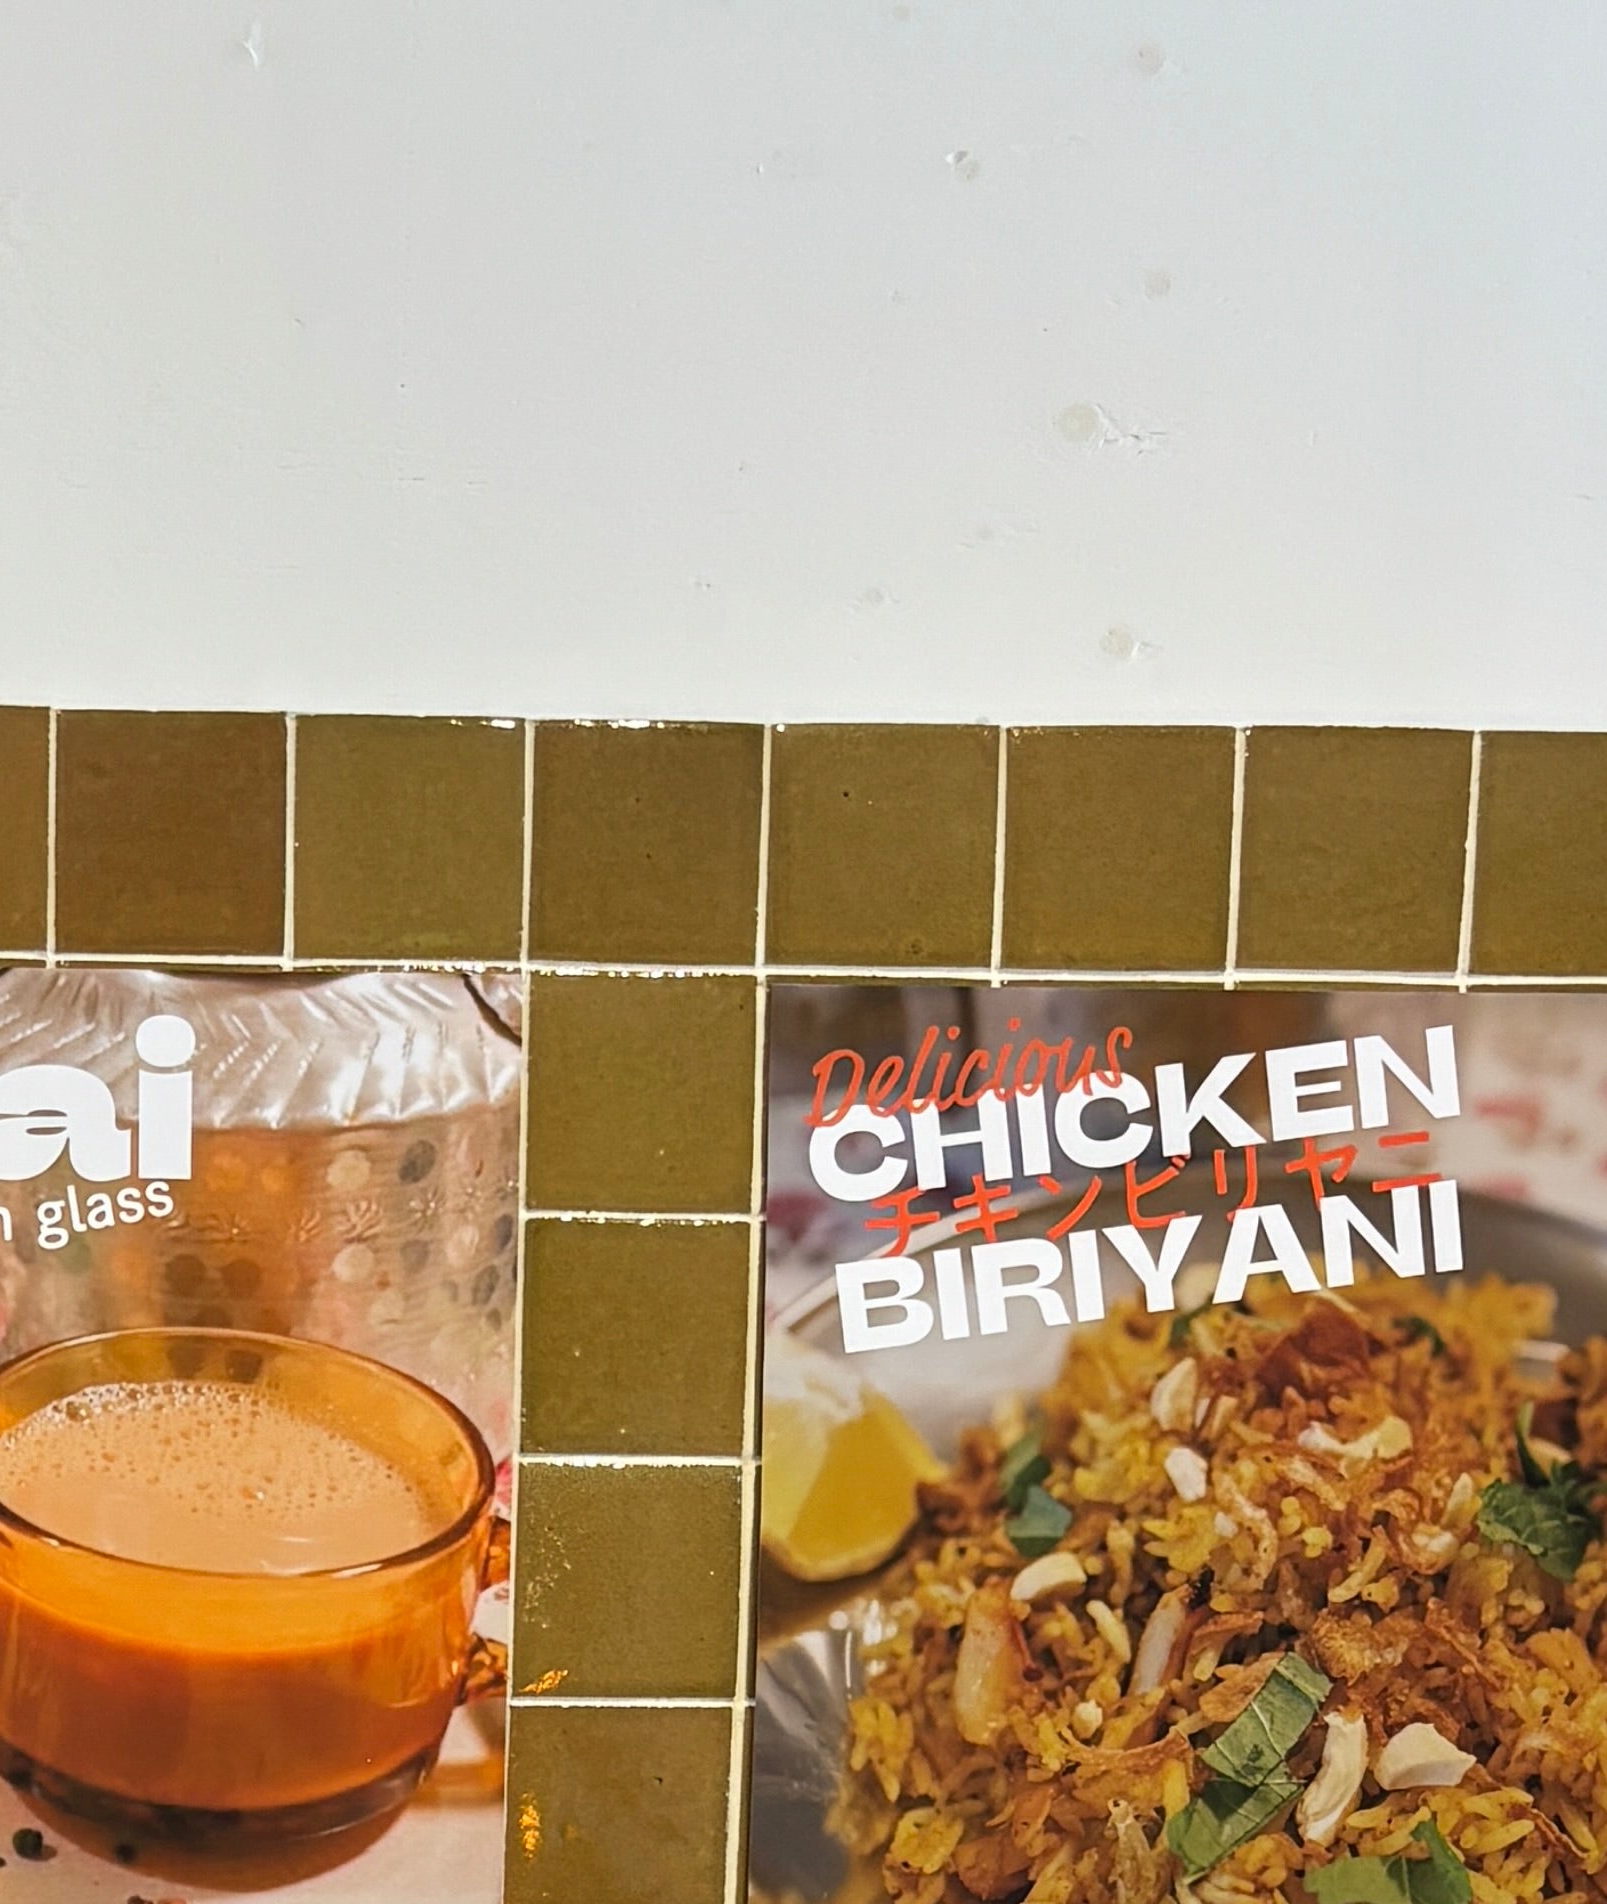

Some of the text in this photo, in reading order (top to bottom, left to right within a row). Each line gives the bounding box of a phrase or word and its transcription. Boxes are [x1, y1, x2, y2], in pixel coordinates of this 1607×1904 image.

[808, 1017, 1132, 1128] Delicious
[808, 1025, 1462, 1202] CHICKEN
[38, 1180, 175, 1251] glass
[864, 1131, 1442, 1258] チキンビリヤニ
[835, 1180, 1464, 1354] BIRIYANI
